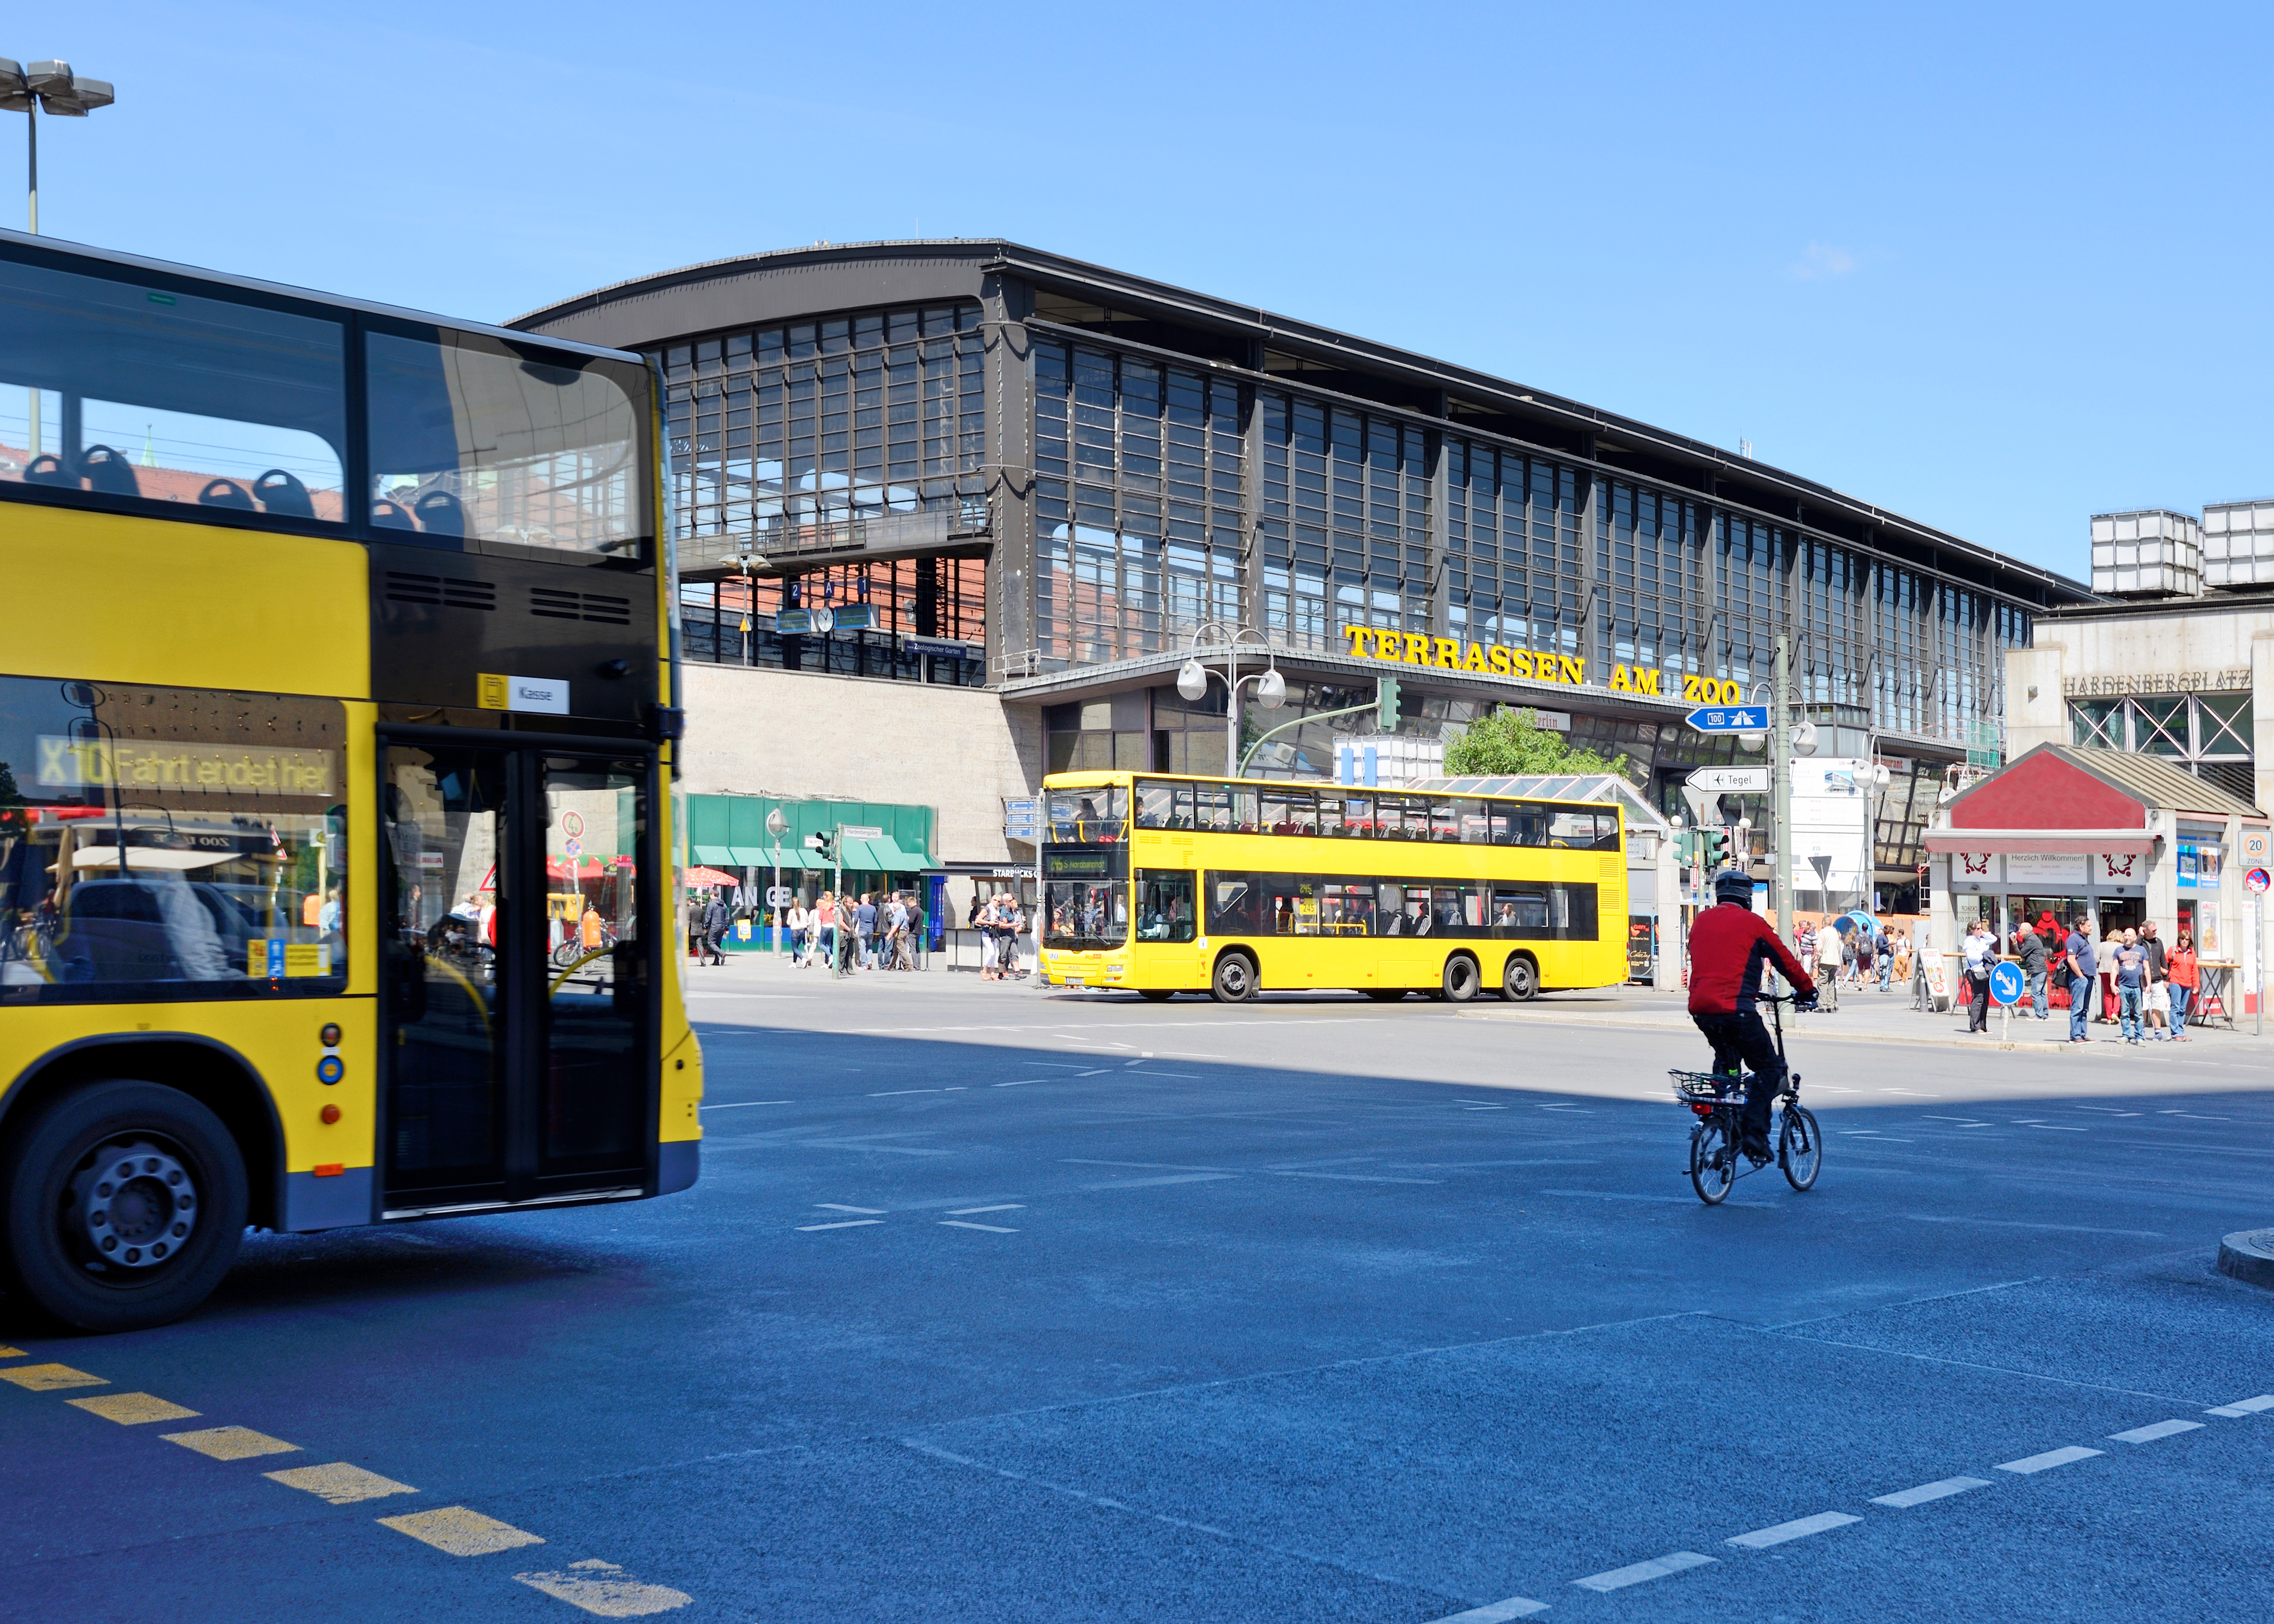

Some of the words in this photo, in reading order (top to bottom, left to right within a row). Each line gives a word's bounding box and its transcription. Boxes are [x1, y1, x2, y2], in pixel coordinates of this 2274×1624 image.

[793, 584, 798, 596] 2
[826, 582, 832, 593] A
[862, 579, 866, 590] 1
[914, 643, 944, 653] Zoologischer
[945, 647, 961, 655] Garten
[1343, 625, 1586, 685] TERRASSEN
[1607, 664, 1660, 696] AM
[1682, 674, 1740, 705] ZOO
[2063, 670, 2251, 692] HARDENBERGPLATZ
[519, 686, 553, 701] Kasse
[1710, 715, 1722, 723] 100
[1873, 755, 1903, 769] etaurant
[115, 749, 190, 784] Fahrt
[197, 755, 279, 787] endet
[1728, 775, 1752, 786] Tegel
[568, 817, 575, 832] 4
[2249, 840, 2262, 850] 20
[1064, 860, 1068, 868] S
[1070, 860, 1105, 868] Nordbahnhof
[803, 869, 821, 877] Change
[1300, 884, 1312, 893] 245
